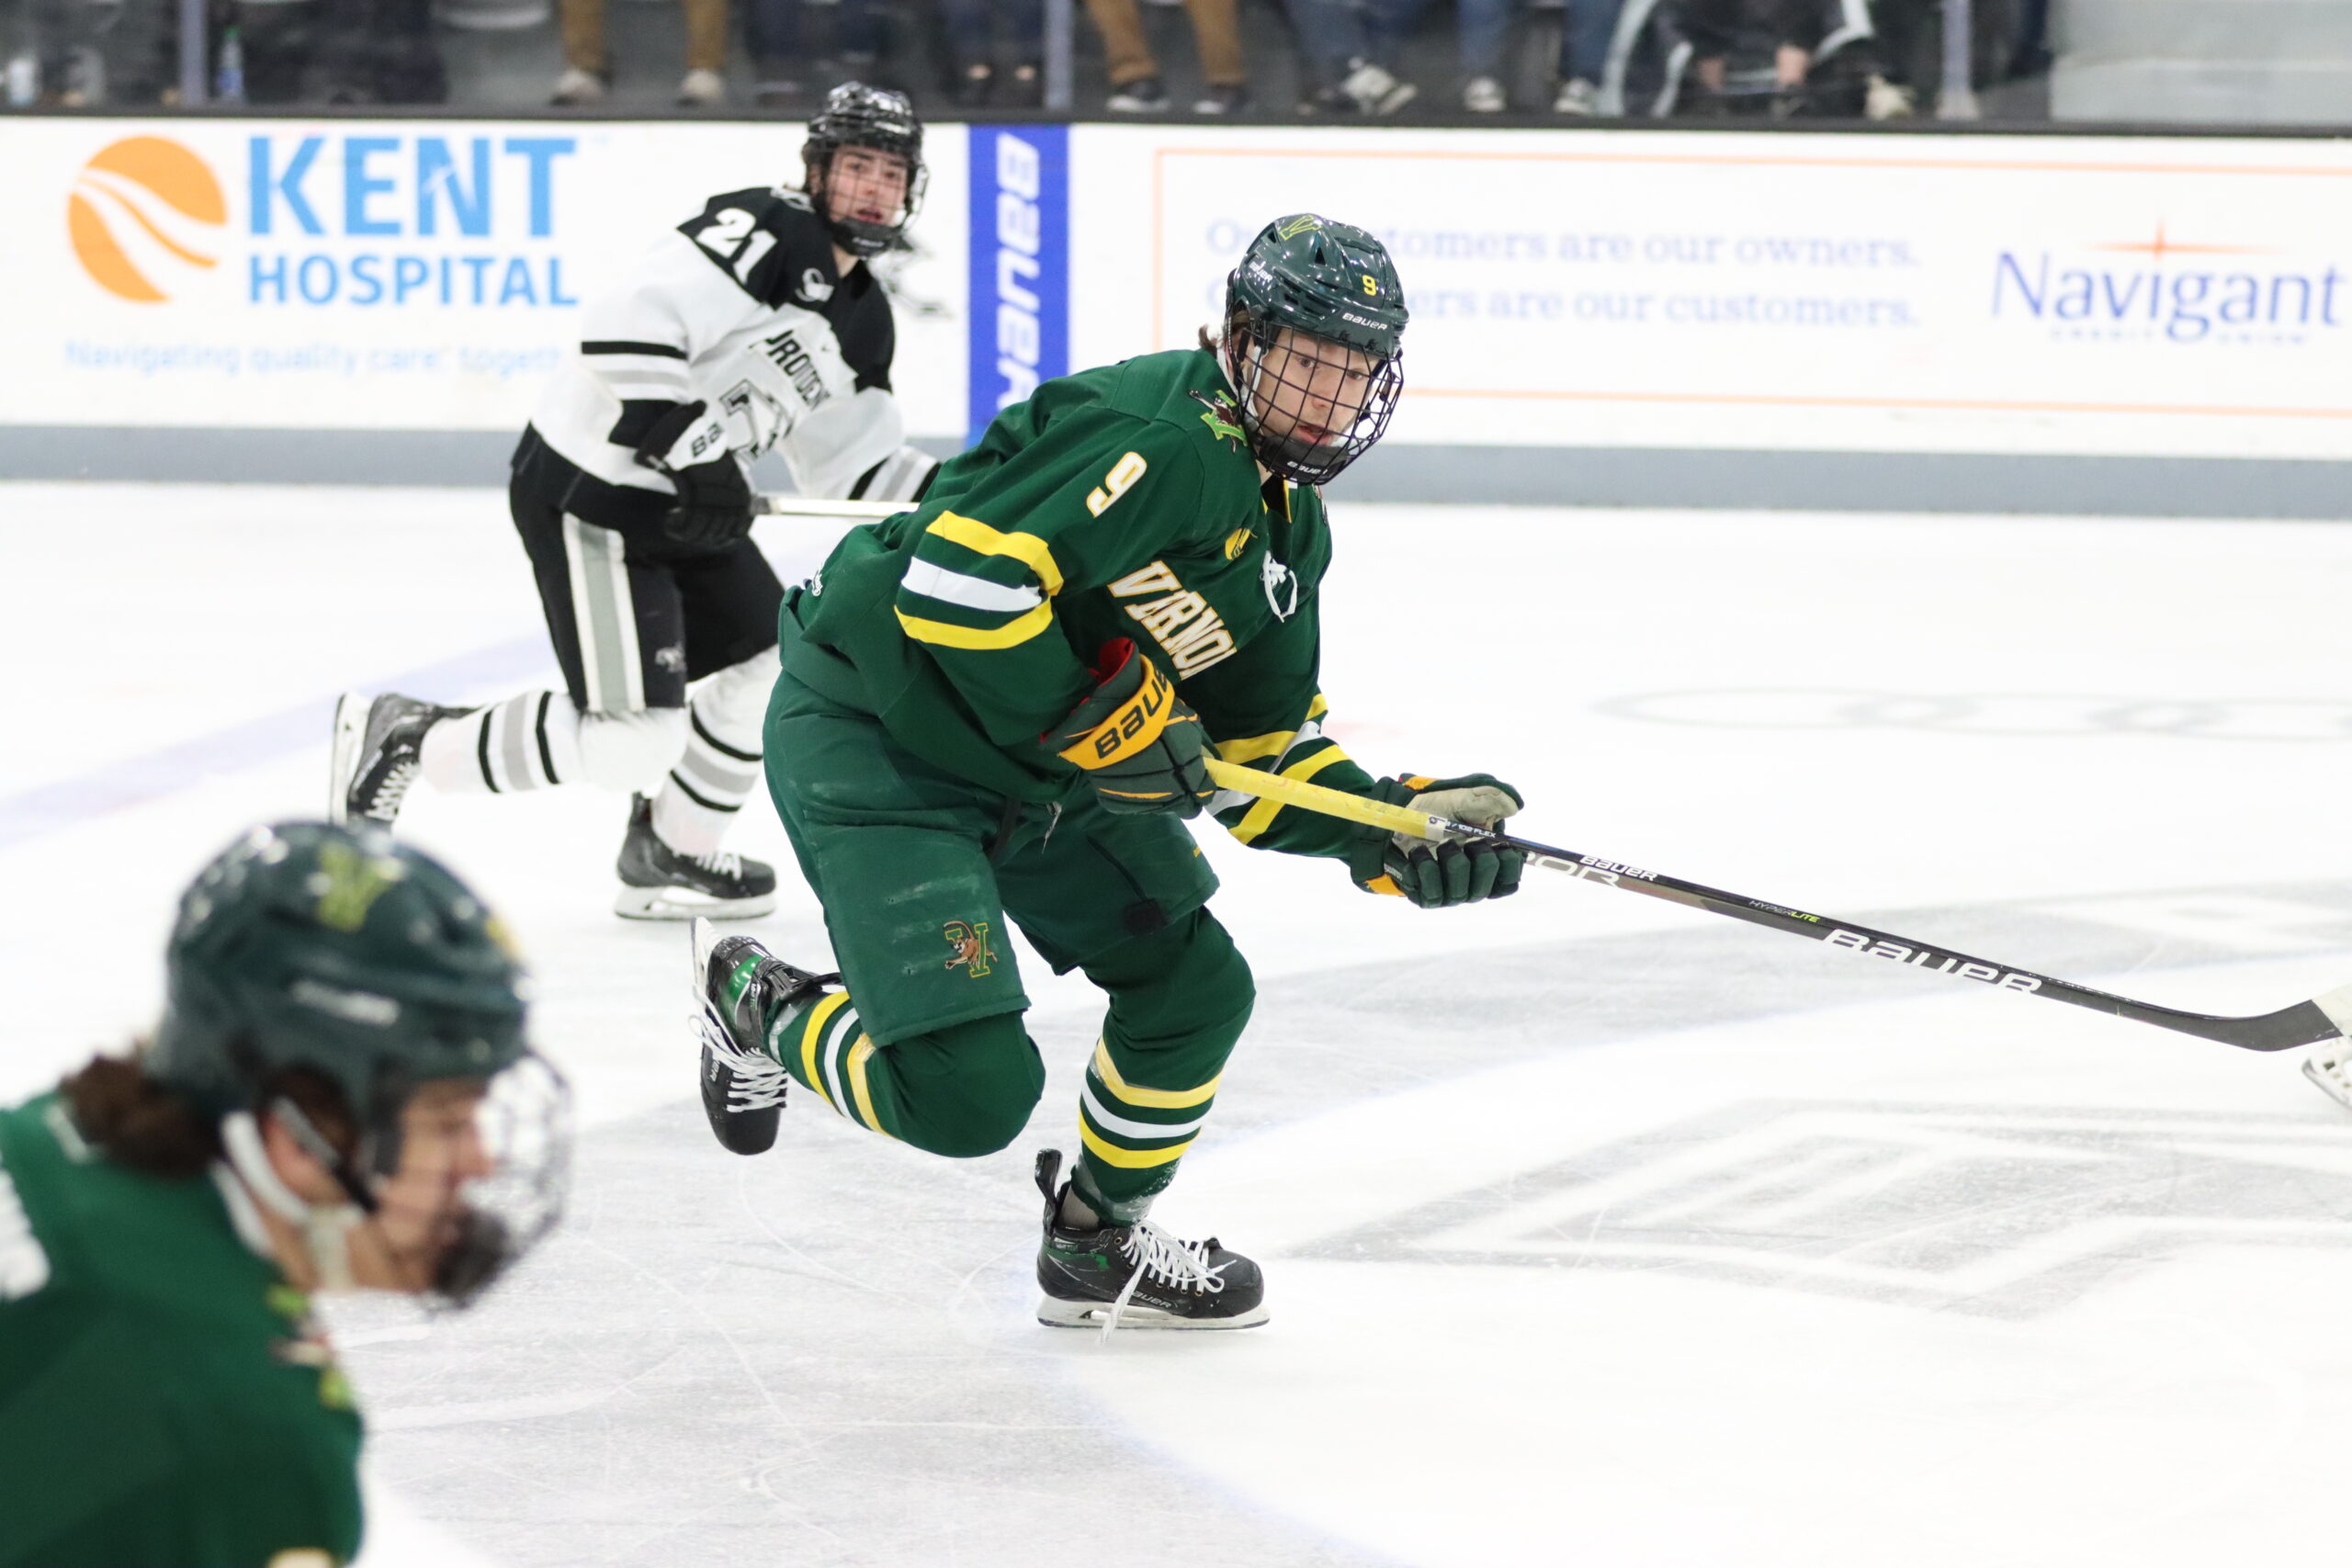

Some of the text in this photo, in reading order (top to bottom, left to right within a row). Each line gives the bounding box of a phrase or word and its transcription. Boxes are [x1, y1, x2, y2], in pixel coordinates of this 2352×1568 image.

[250, 135, 576, 237] KENT
[695, 208, 778, 285] 21
[1558, 231, 1634, 263] are
[1644, 232, 1726, 264] our
[1734, 235, 1922, 267] owners.
[250, 254, 579, 306] HOSPITAL
[1362, 274, 1377, 297] 9
[1991, 249, 2348, 344] Navigant
[1341, 312, 1388, 332] BAUER
[1487, 289, 1564, 320] are
[1573, 290, 1656, 321] our
[1664, 292, 1922, 328] customers.
[65, 339, 238, 378] Navigating
[249, 340, 356, 378] quality
[1086, 451, 1148, 518] 9
[1579, 854, 1658, 882] BAUER
[1824, 929, 2042, 994] BAUER
[1131, 1292, 1172, 1309] AUER
